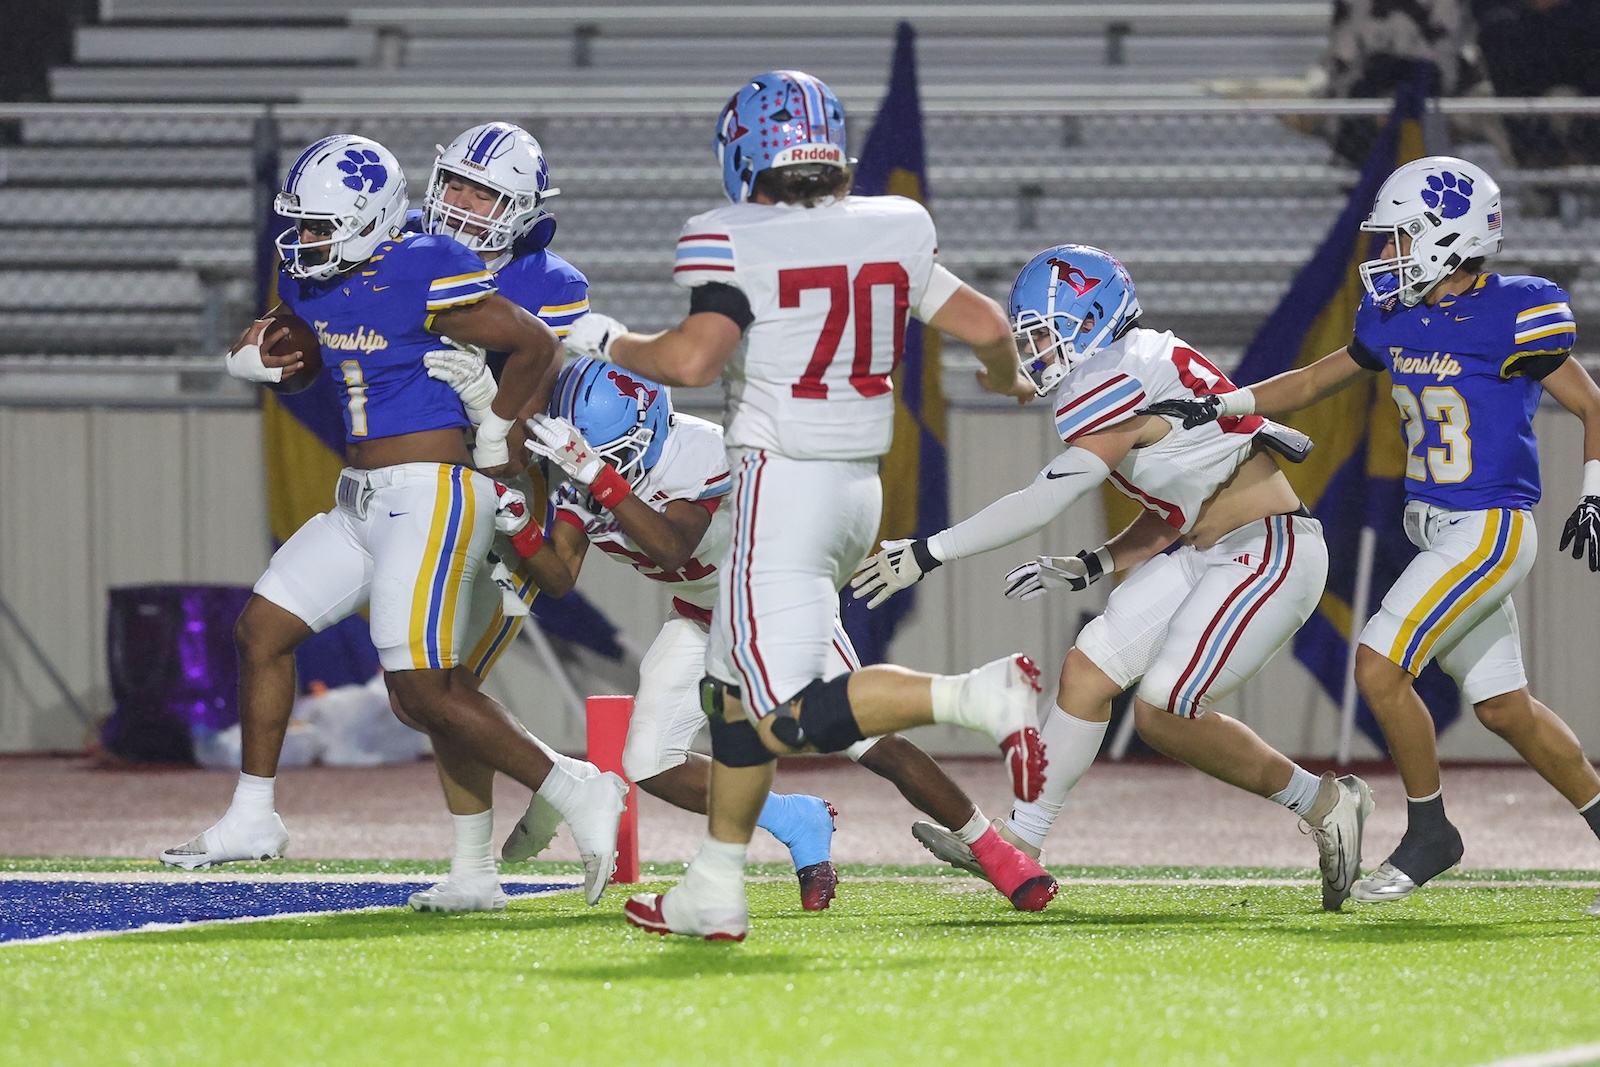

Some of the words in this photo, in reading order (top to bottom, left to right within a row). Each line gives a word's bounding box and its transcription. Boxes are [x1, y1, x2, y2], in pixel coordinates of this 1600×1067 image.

[791, 147, 840, 162] Riddell
[314, 320, 388, 355] Frenship
[778, 262, 909, 399] 70
[1389, 346, 1462, 382] Frenship
[340, 360, 369, 436] 1
[1391, 384, 1473, 484] 23
